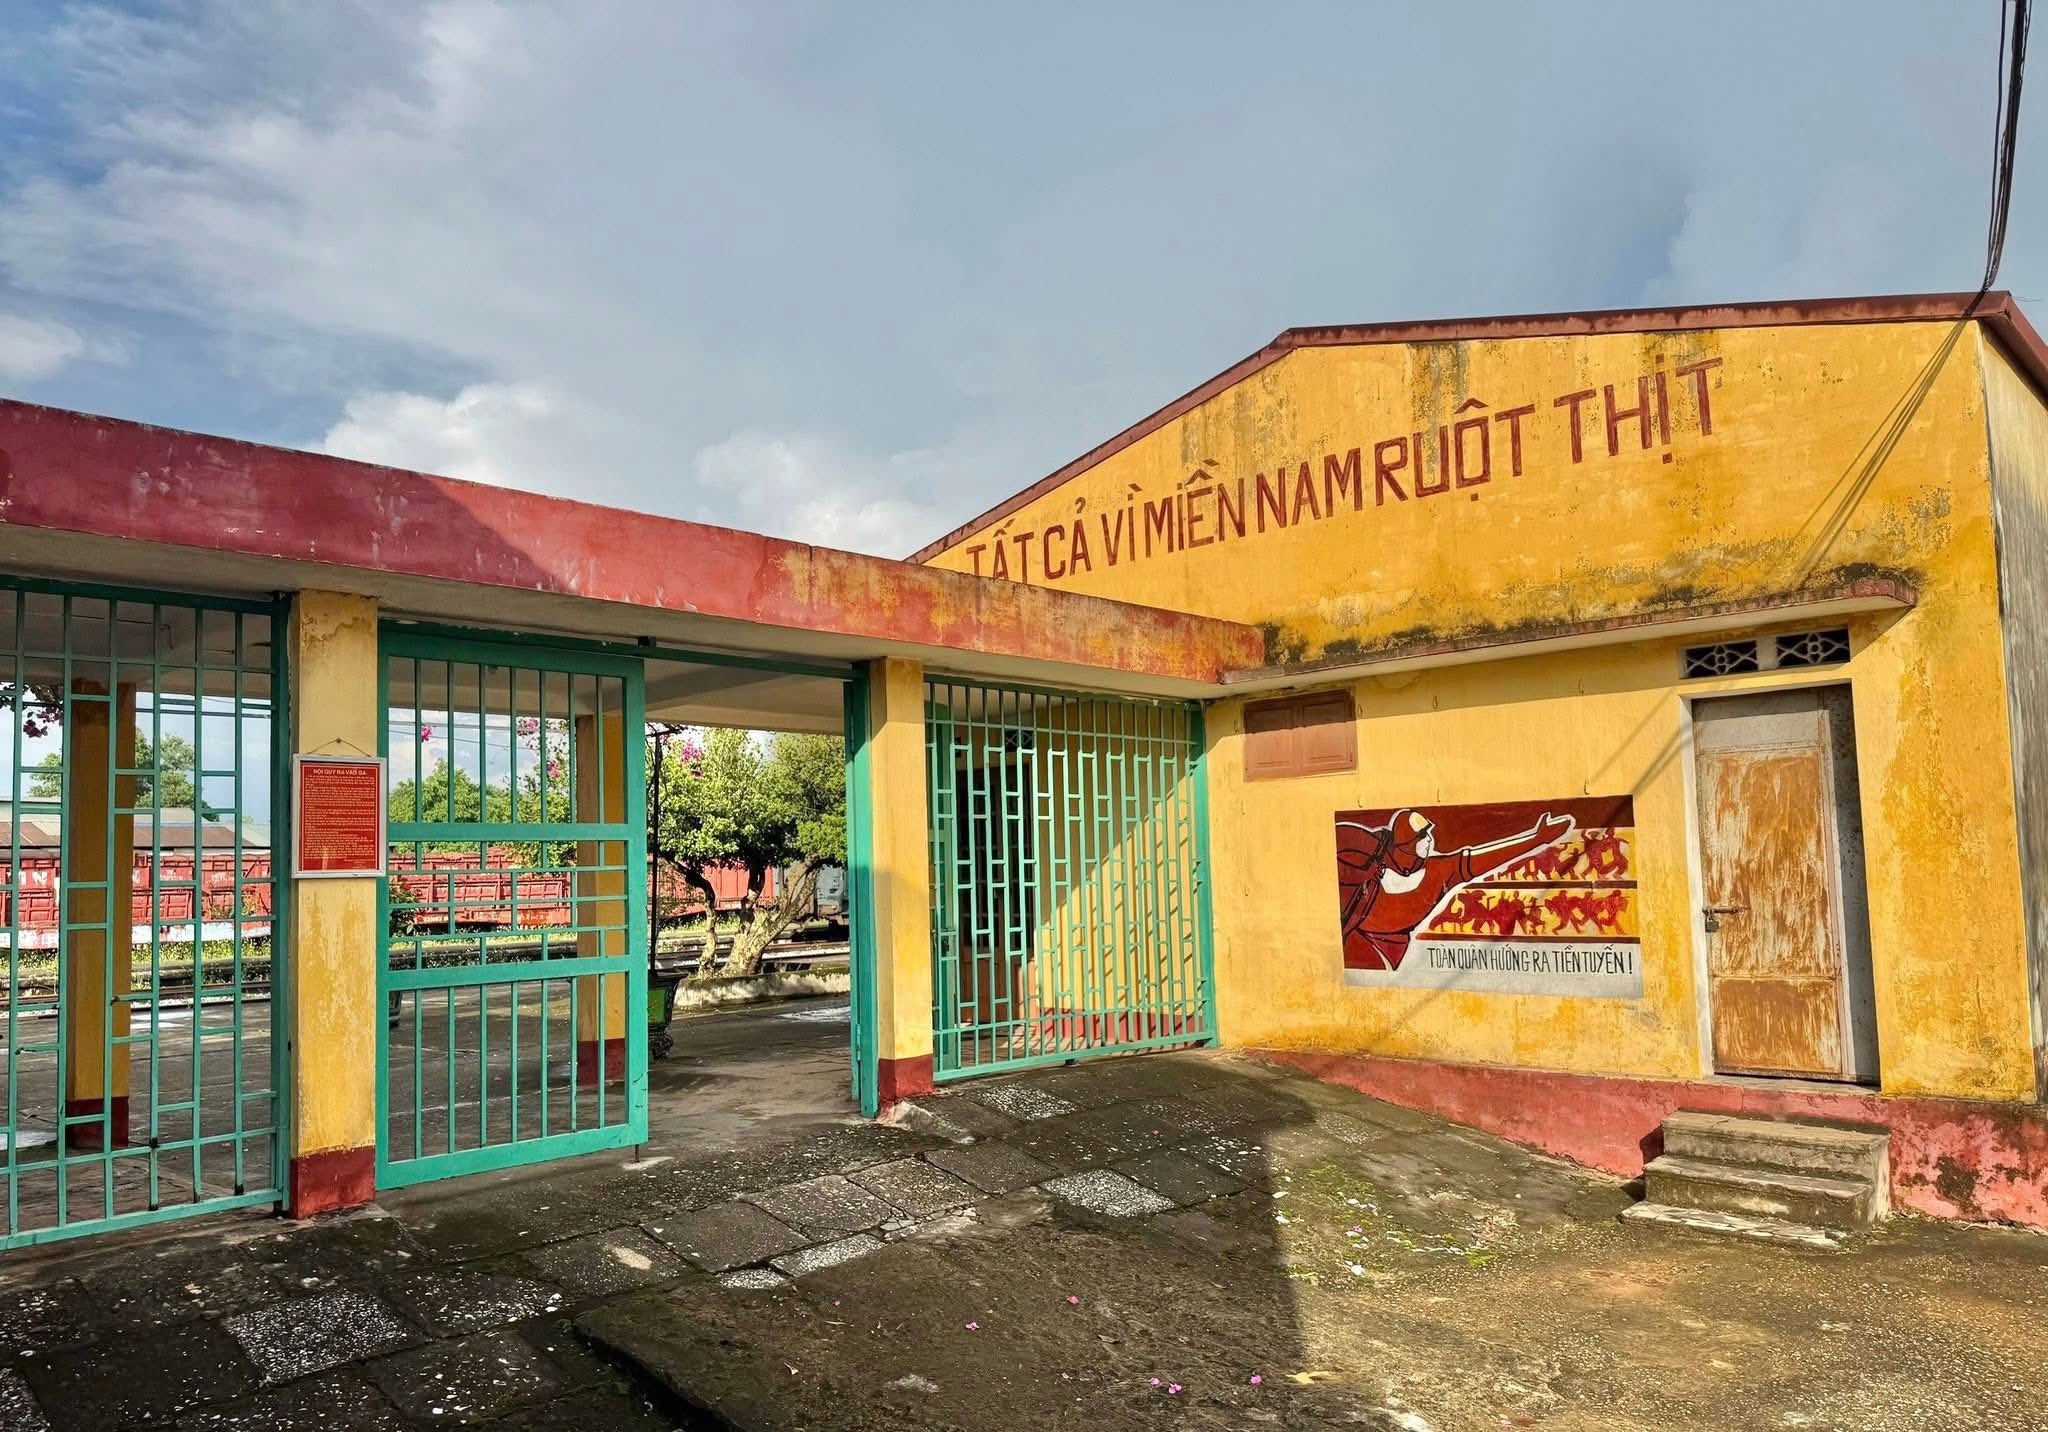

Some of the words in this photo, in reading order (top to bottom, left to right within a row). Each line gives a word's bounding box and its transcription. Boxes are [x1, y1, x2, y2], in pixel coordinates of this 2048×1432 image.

[966, 518, 1034, 584] TẤT
[1043, 497, 1092, 580] CẢ
[1101, 483, 1142, 566] VÌ
[1143, 458, 1246, 559] MIỀN
[1255, 447, 1363, 533] NAM
[1374, 398, 1535, 507] RUỘT
[1554, 353, 1723, 465] THỊT
[1427, 943, 1456, 968] TOÀN
[1457, 943, 1488, 970] QUÂN
[1532, 951, 1551, 973] RA
[1552, 945, 1580, 973] TIỀN
